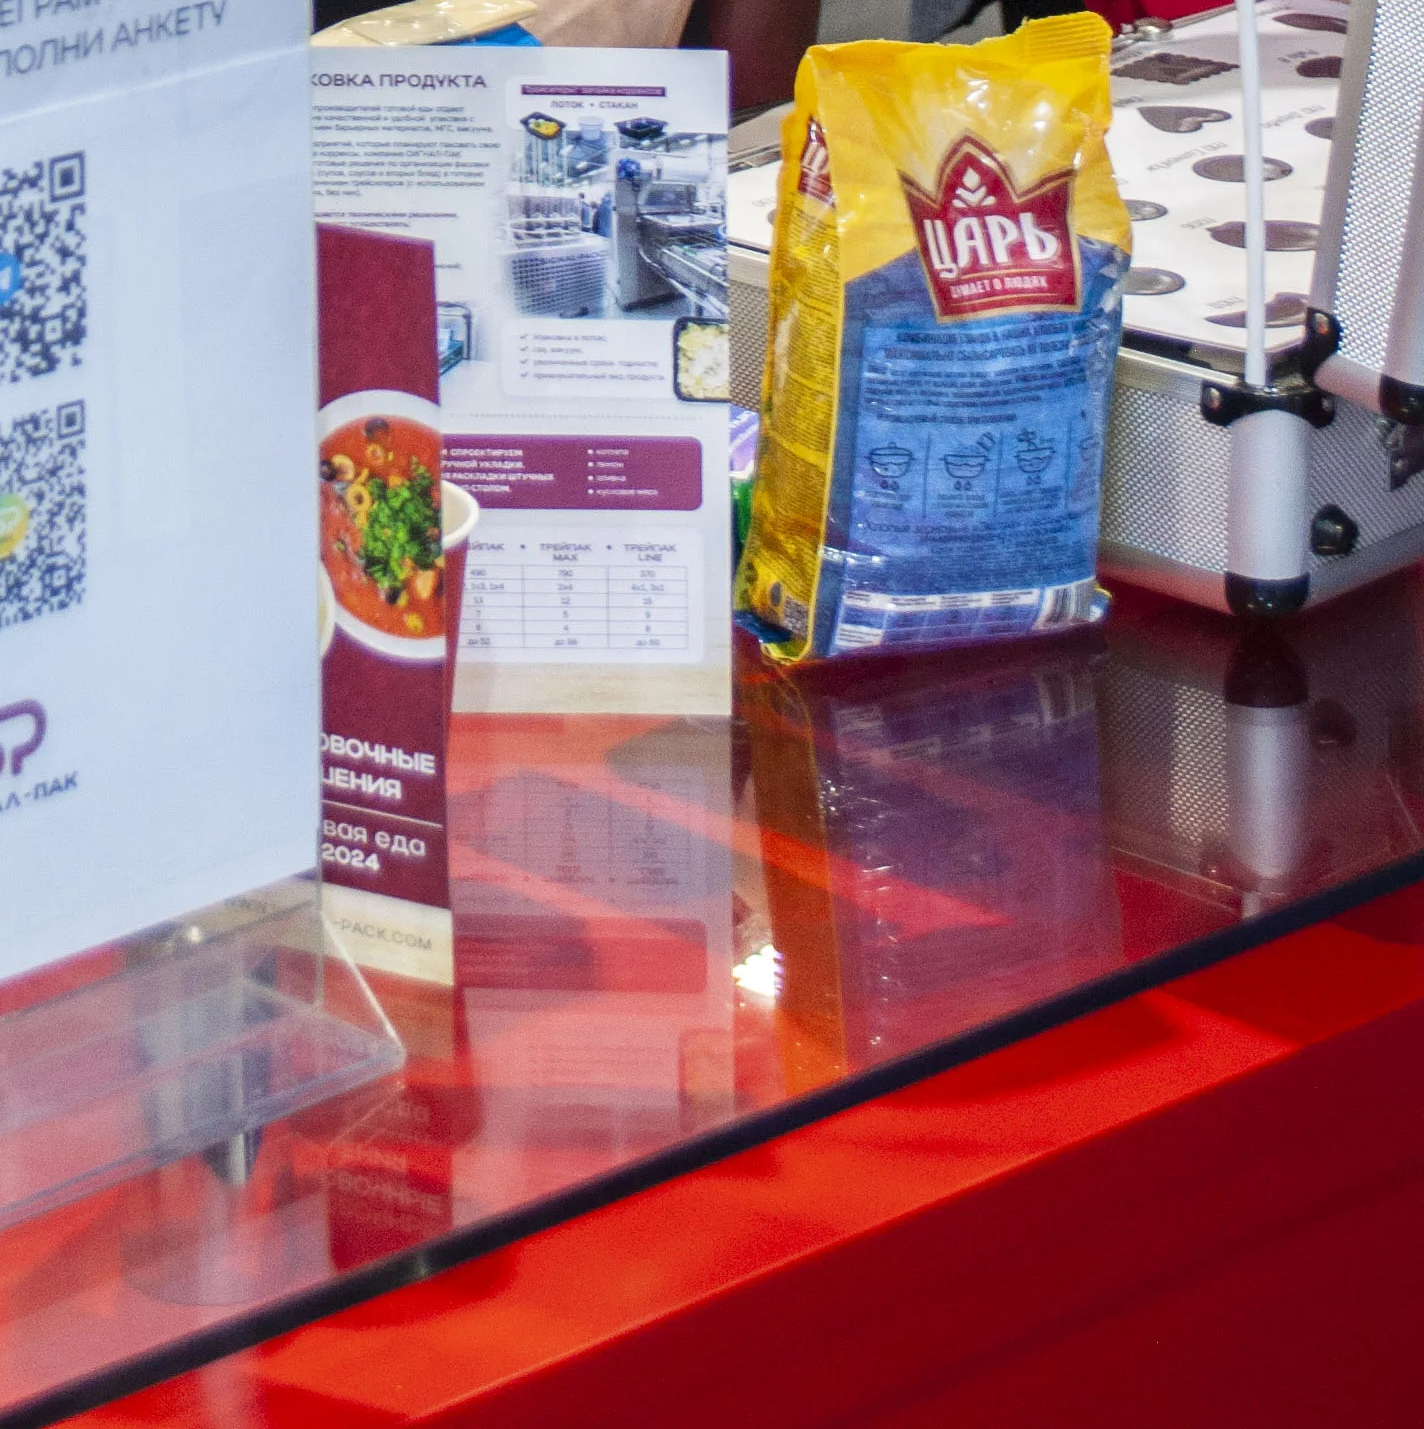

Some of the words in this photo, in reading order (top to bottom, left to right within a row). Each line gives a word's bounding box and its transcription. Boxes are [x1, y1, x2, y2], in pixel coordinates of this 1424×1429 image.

[379, 73, 487, 90] ПРОДУКТА
[923, 212, 1058, 279] ЦАРЬ
[374, 831, 426, 857] еда
[322, 844, 381, 871] 2024
